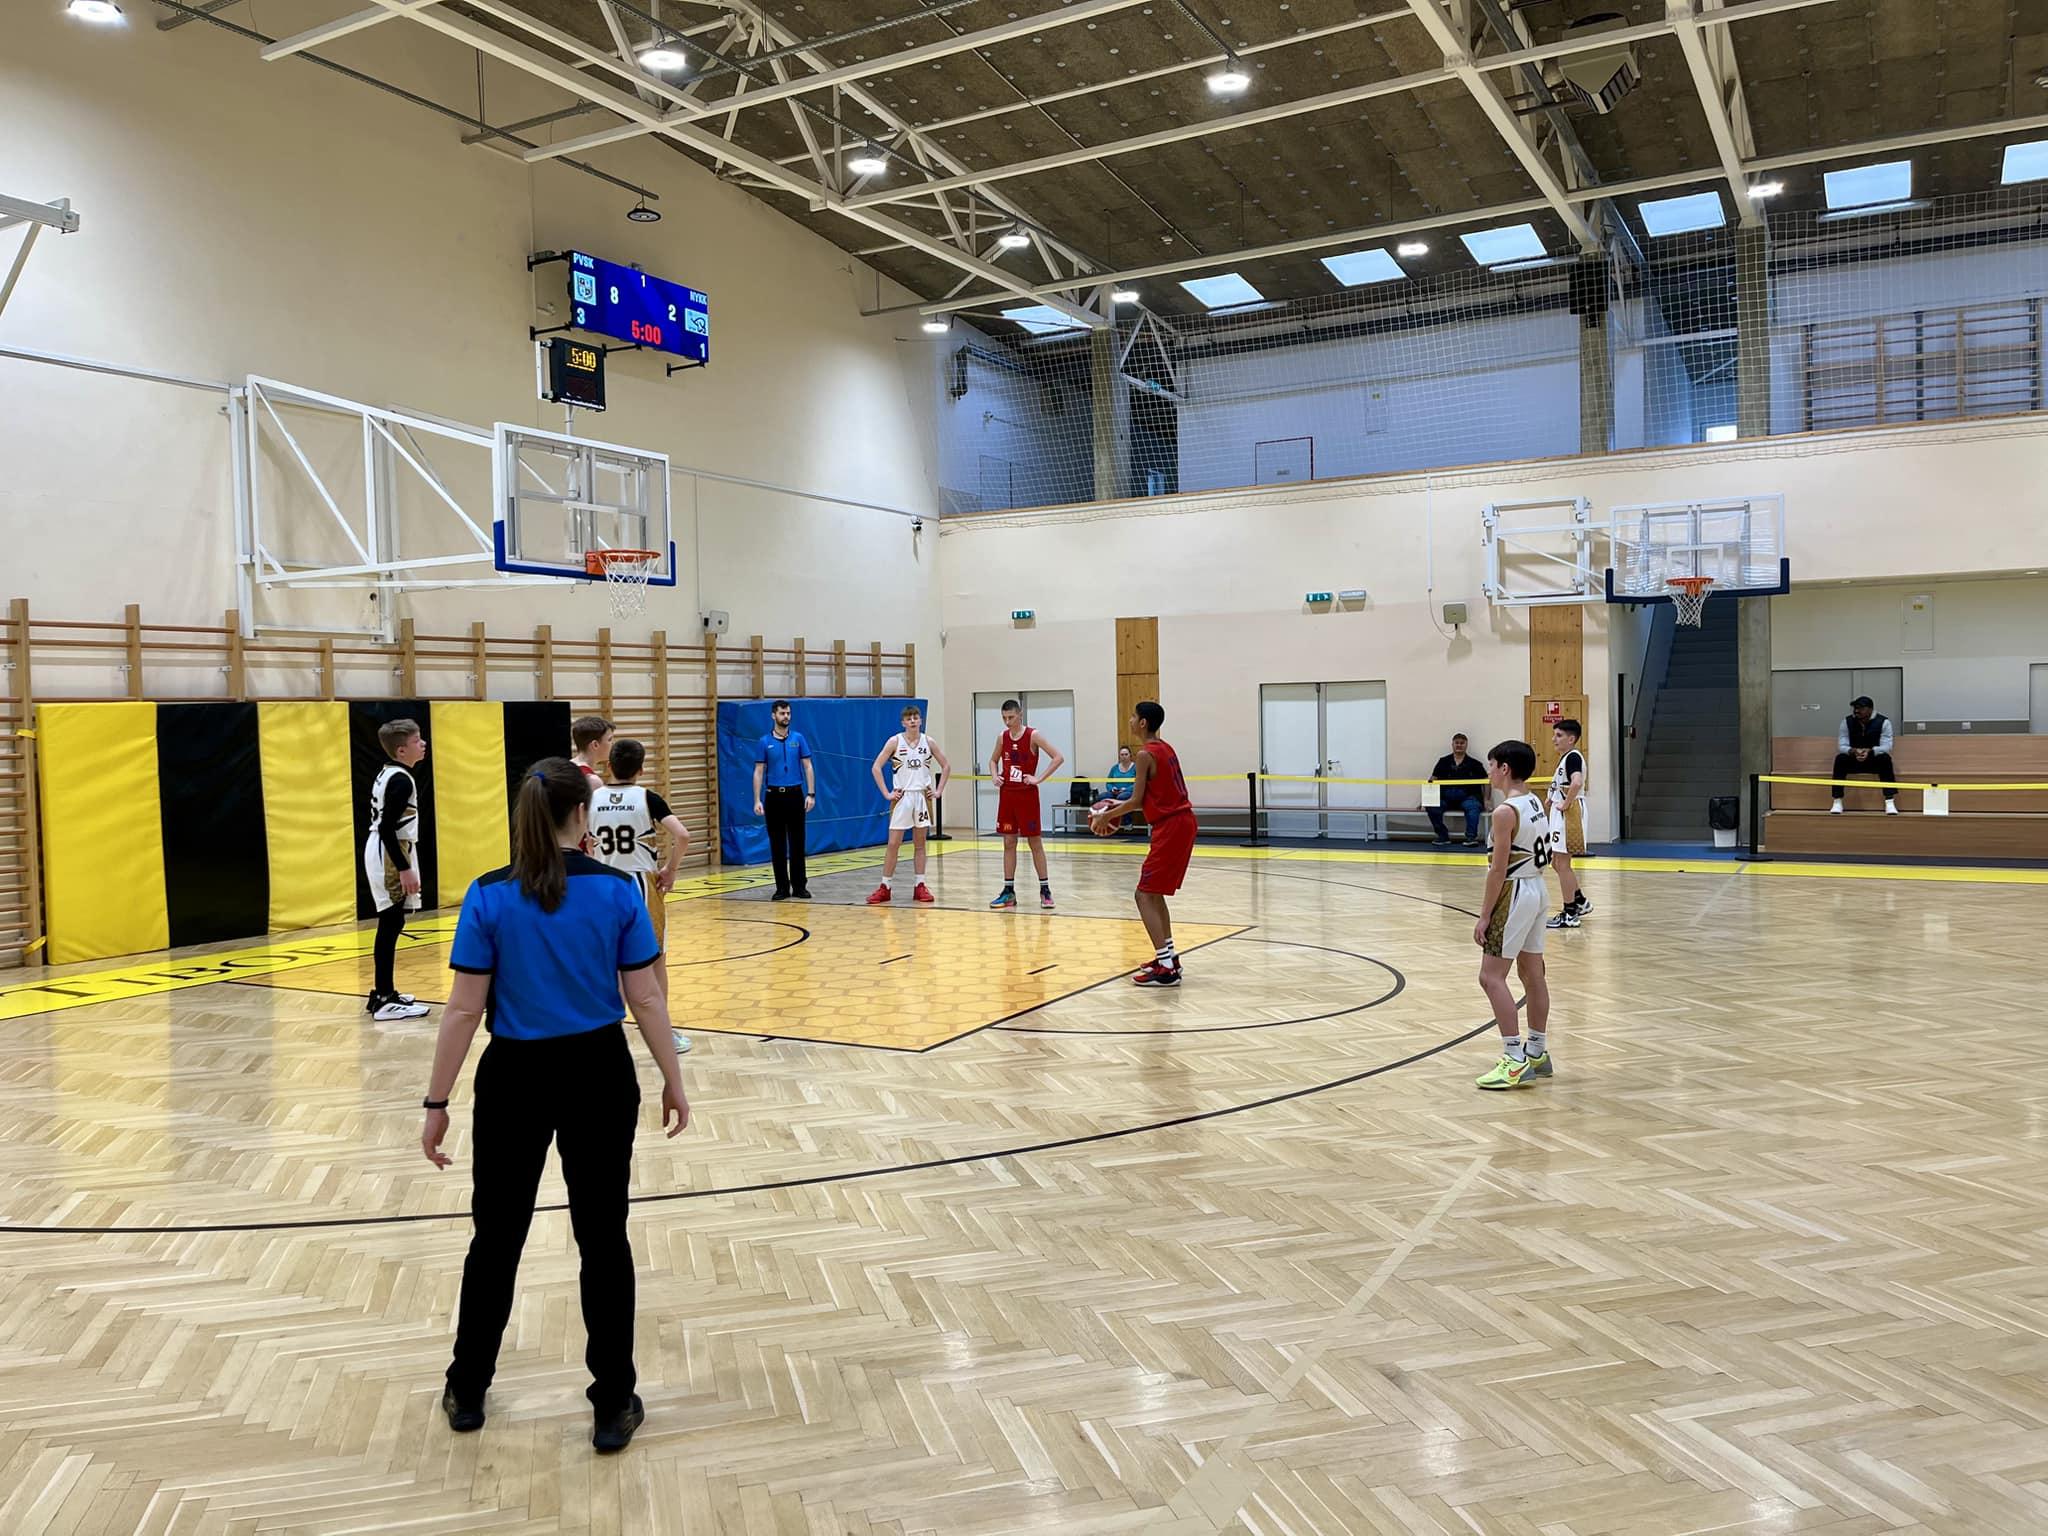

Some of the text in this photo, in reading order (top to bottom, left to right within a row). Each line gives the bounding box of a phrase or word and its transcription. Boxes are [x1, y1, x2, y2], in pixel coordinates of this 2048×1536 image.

[573, 253, 593, 268] PVSK
[641, 275, 646, 287] 1
[610, 286, 619, 304] 8
[577, 307, 586, 324] 3
[668, 304, 676, 321] 2
[632, 320, 660, 344] 5:00
[571, 348, 596, 367] 5:00
[700, 343, 705, 358] 1
[918, 811, 928, 822] 24
[596, 825, 636, 855] 38
